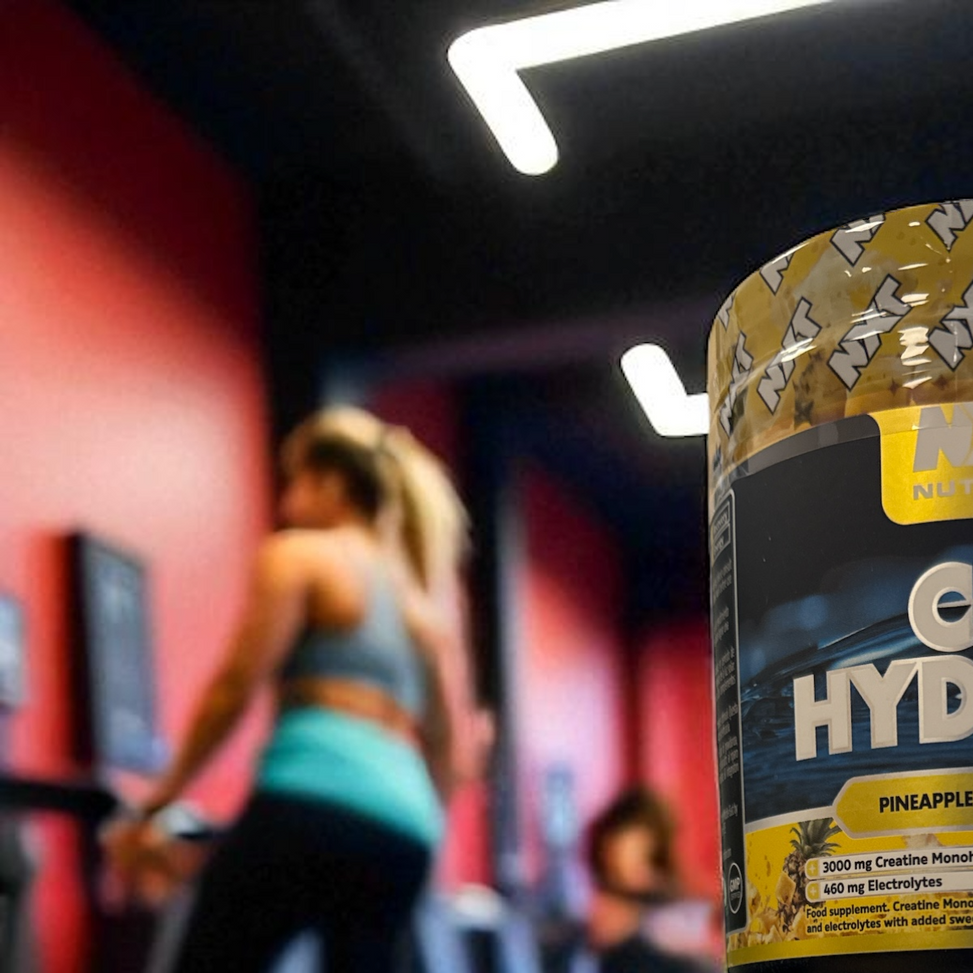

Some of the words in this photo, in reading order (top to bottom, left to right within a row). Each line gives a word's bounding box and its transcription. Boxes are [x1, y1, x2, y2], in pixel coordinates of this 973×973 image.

[827, 274, 913, 392] NXT
[757, 296, 822, 411] NXT
[879, 790, 973, 813] PINEAPPLE
[822, 859, 851, 873] 3000
[854, 860, 872, 872] mg
[875, 854, 928, 869] Creatine
[823, 883, 844, 895] 460
[847, 884, 865, 895] mg
[868, 876, 942, 892] Electrolytes
[806, 906, 827, 918] Food
[829, 902, 890, 917] supplement.
[893, 899, 940, 912] Creatine
[807, 922, 822, 933] and
[824, 918, 881, 932] electrolytes
[884, 916, 908, 927] with
[911, 914, 946, 925] added
